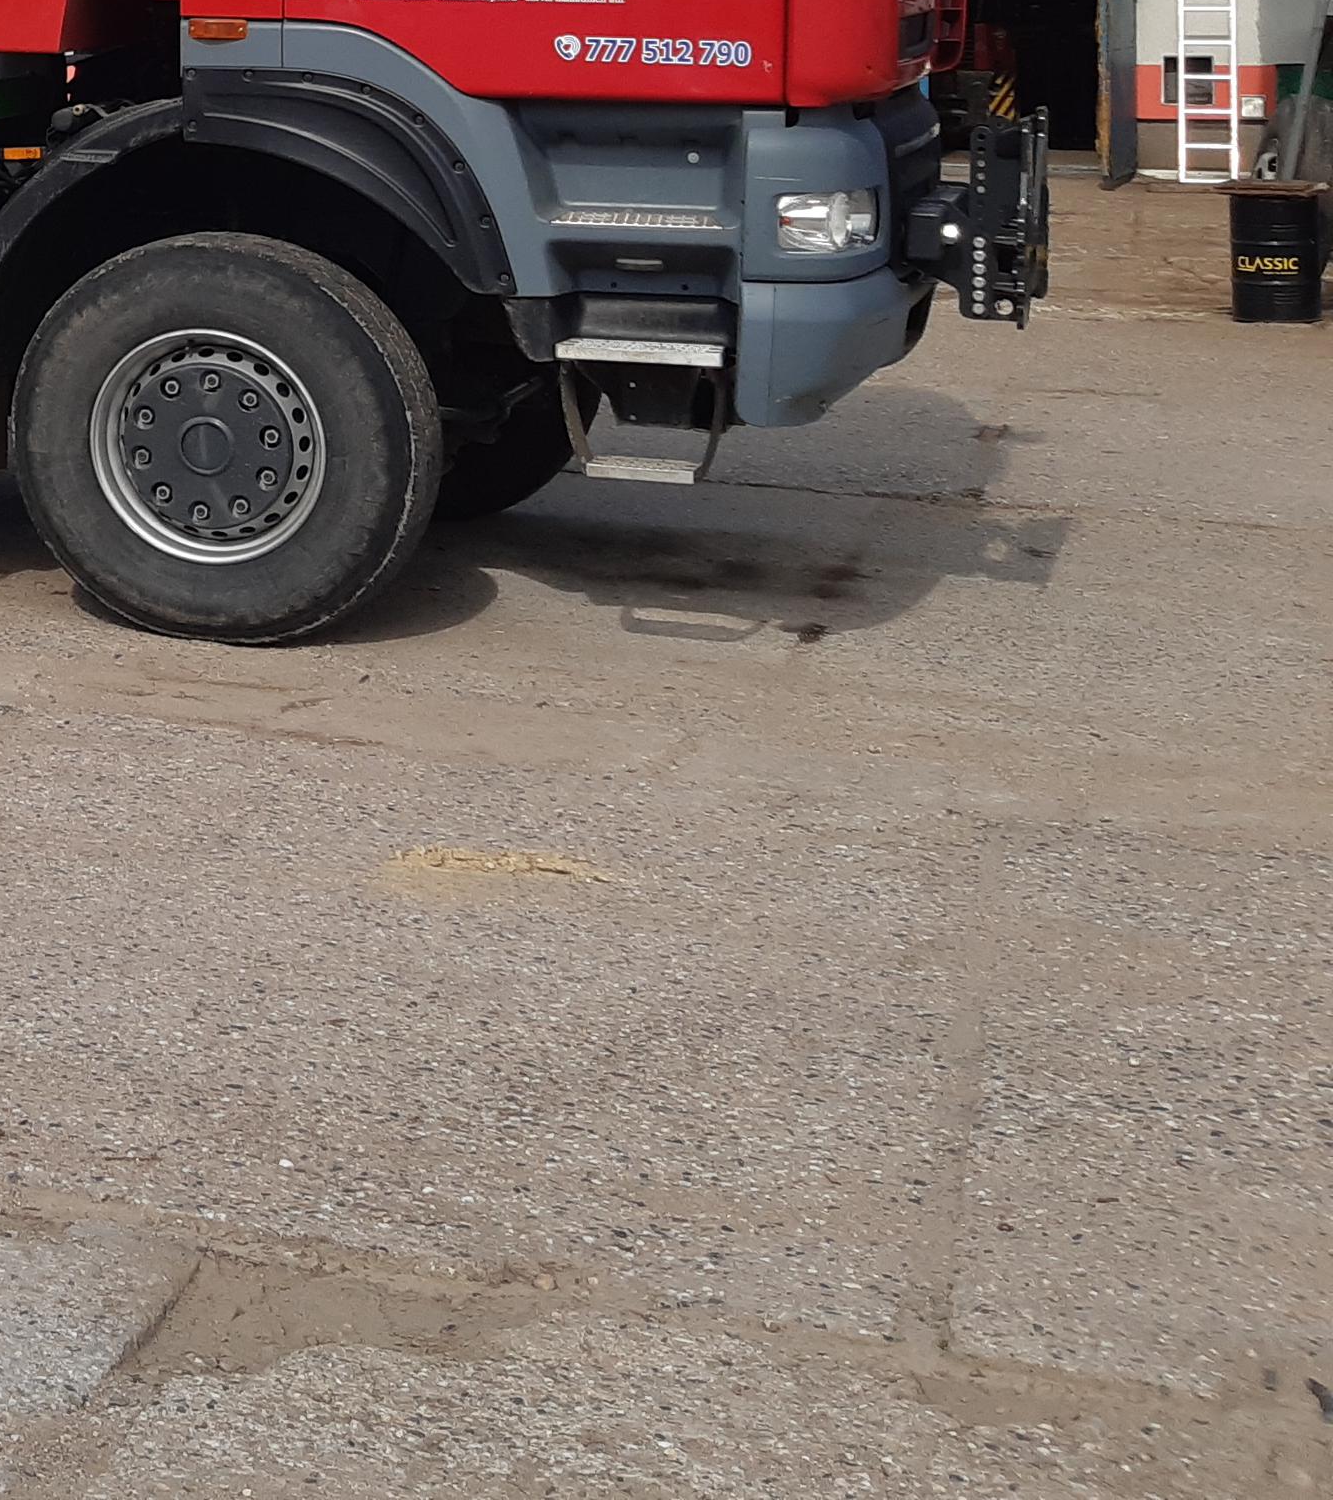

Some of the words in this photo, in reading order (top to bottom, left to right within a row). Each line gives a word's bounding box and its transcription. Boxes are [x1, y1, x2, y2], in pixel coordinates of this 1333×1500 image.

[585, 36, 636, 62] 777
[641, 38, 693, 65] 512
[699, 40, 752, 67] 790
[1236, 255, 1300, 272] CLASSIC
